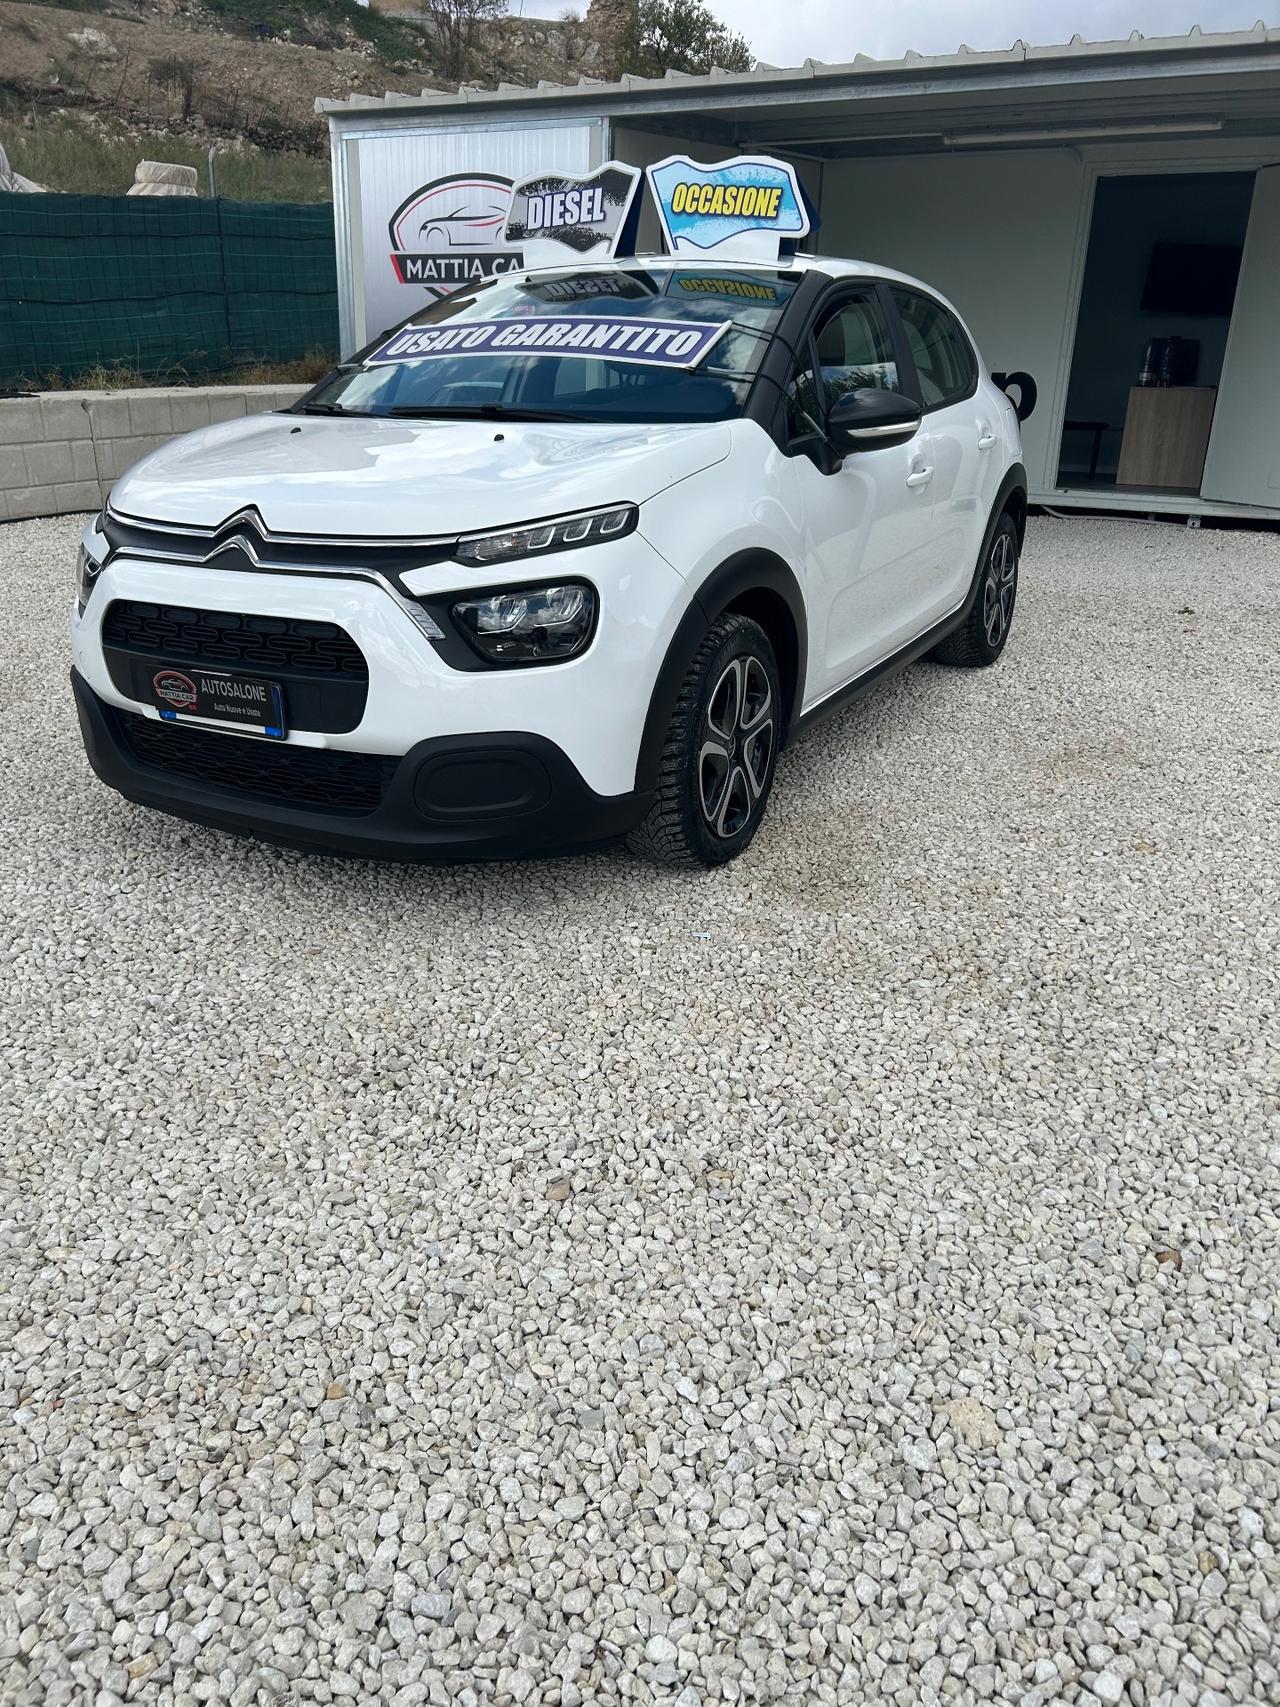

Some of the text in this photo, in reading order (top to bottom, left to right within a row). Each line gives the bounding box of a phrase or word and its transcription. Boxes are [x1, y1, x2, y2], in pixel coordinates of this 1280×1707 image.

[527, 187, 605, 230] DIESEL
[671, 182, 783, 218] OCCASIONE
[406, 258, 485, 279] MATTIA
[386, 323, 703, 356] USATO GARANTITO
[160, 689, 194, 701] MATTIA CAR
[201, 679, 268, 702] AUTOSALONE
